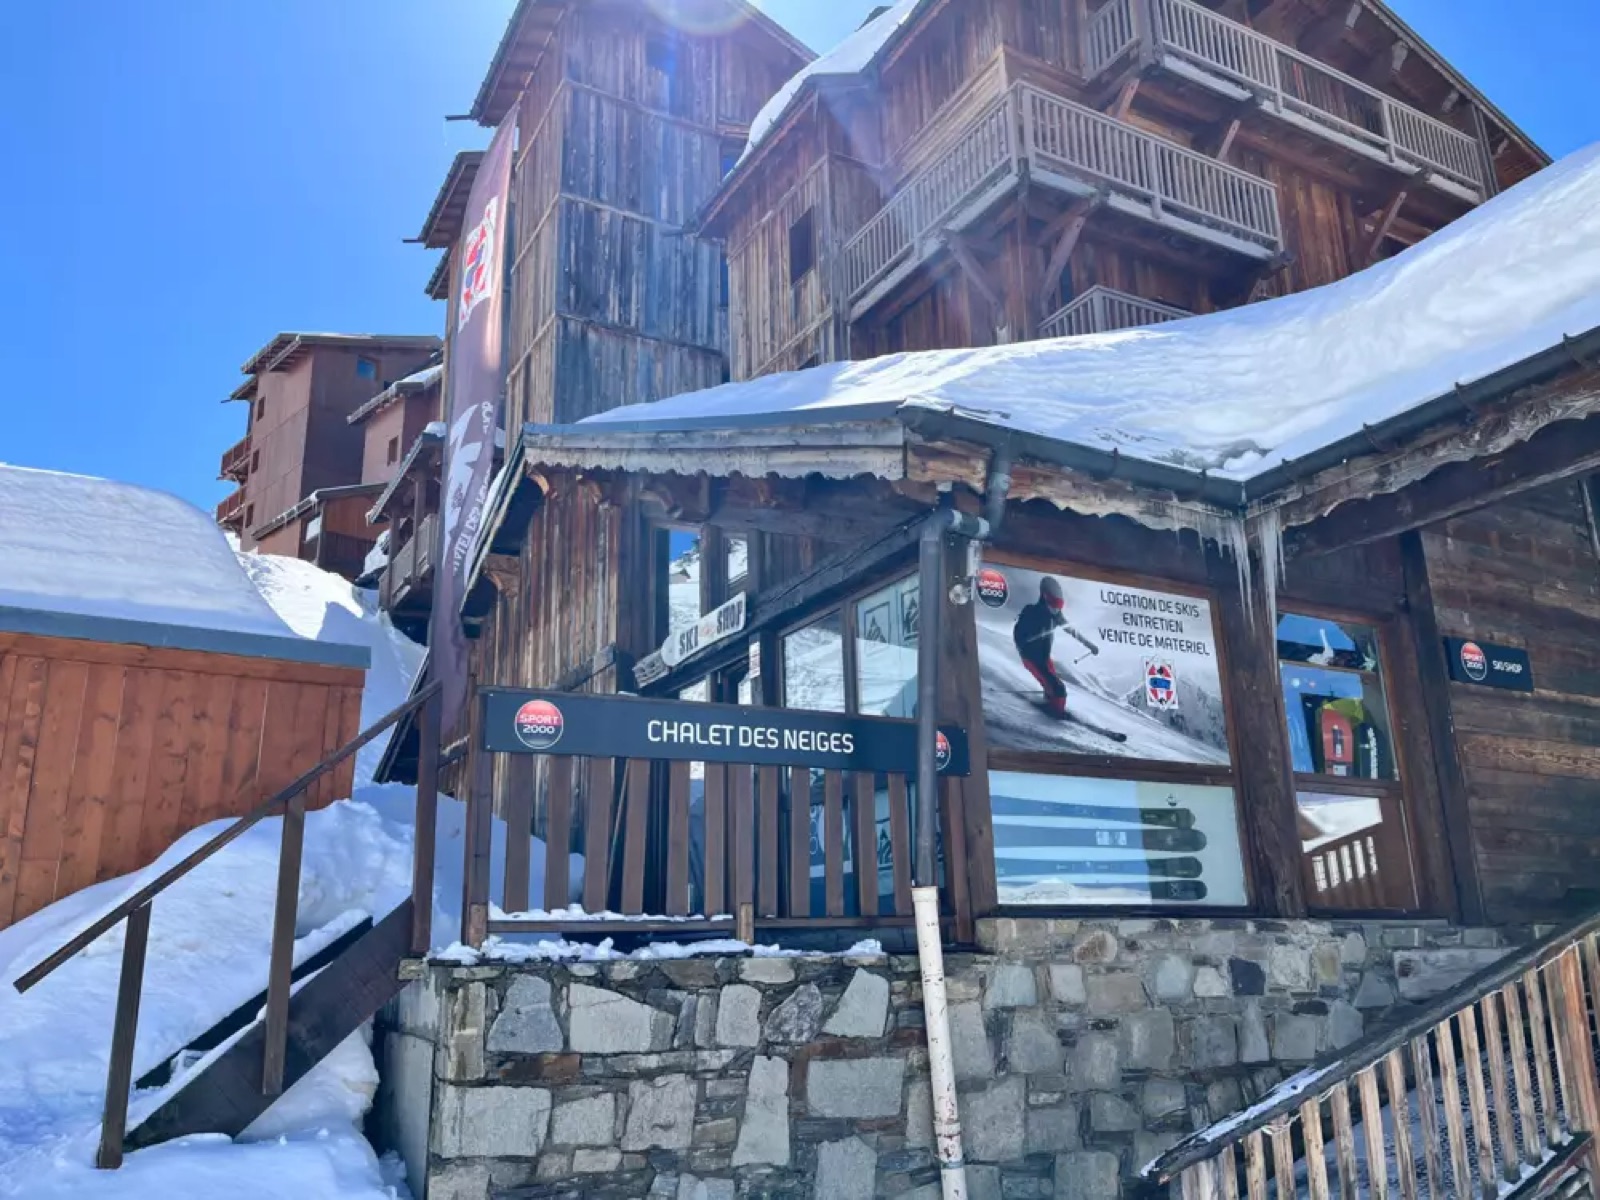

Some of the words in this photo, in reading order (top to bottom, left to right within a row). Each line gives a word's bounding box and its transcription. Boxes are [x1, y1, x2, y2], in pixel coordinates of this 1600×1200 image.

[1100, 589, 1156, 611] LOCATION
[1159, 599, 1174, 614] DE
[1175, 602, 1200, 618] SKIS
[679, 625, 699, 656] SKI
[716, 601, 743, 635] SHOP
[1122, 612, 1184, 634] ENTRETIEN
[1098, 627, 1137, 646] VENTE
[1138, 633, 1154, 649] DE
[1155, 635, 1210, 656] MATERIEL
[519, 713, 559, 724] SPORT
[522, 724, 555, 734] 2000
[647, 719, 735, 747] CHALET
[738, 725, 779, 749] DES
[783, 728, 855, 754] NEIGES
